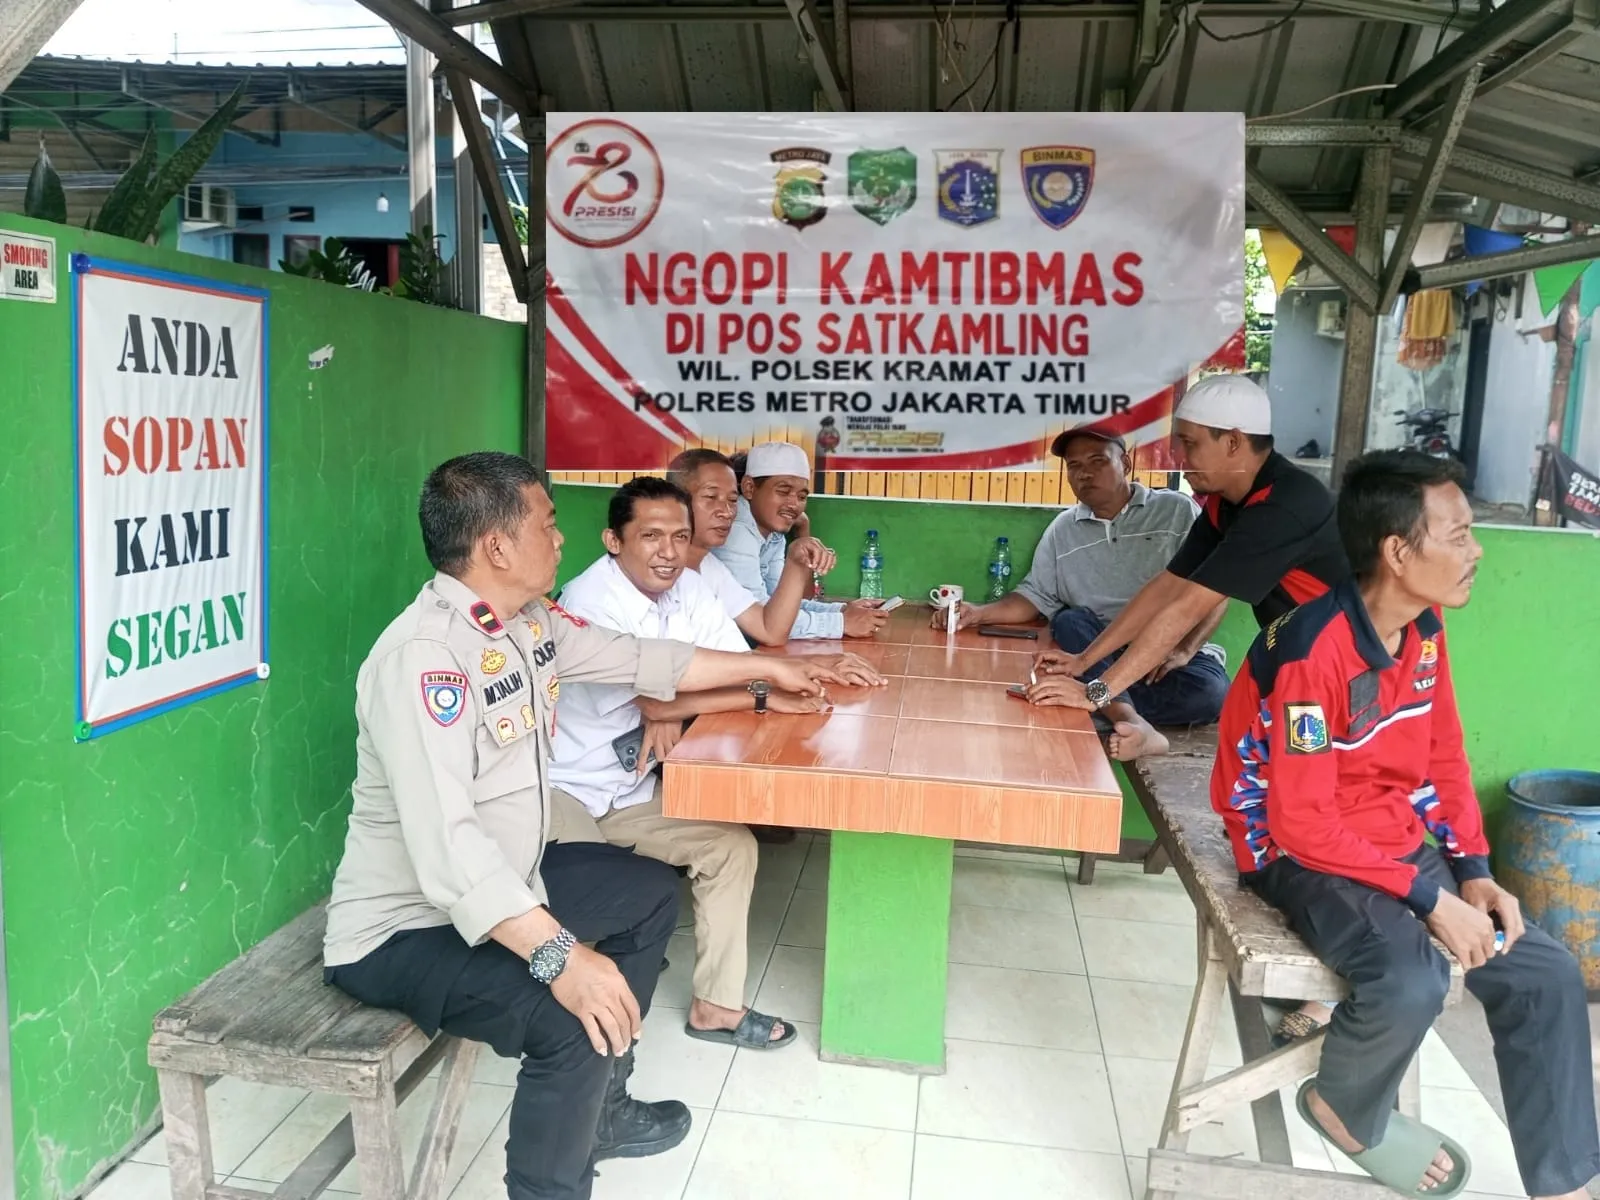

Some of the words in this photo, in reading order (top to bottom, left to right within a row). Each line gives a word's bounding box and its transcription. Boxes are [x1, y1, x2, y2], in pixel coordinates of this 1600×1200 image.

[1032, 150, 1083, 161] BINMAS
[575, 206, 637, 217] PRESISI
[4, 243, 48, 268] SMOKING
[14, 268, 39, 289] AREA
[625, 252, 787, 306] NGOPI
[820, 252, 1144, 306] KAMTIBMAS
[117, 314, 238, 379] ANDA
[666, 313, 703, 354] DI
[718, 313, 801, 354] POS
[817, 313, 1089, 356] SATKAMLING
[678, 360, 739, 381] WIL.
[751, 360, 873, 381] POLSEK
[884, 360, 1012, 382] KRAMAT
[1021, 361, 1085, 383] JATI
[634, 392, 755, 412] POLRES
[766, 392, 872, 413] METRO
[882, 392, 1024, 414] JAKARTA
[1034, 393, 1131, 415] TIMUR
[103, 416, 247, 476] SOPAN
[114, 507, 230, 577] KAMI
[106, 591, 246, 679] SEGAN
[427, 675, 463, 685] BINMAS
